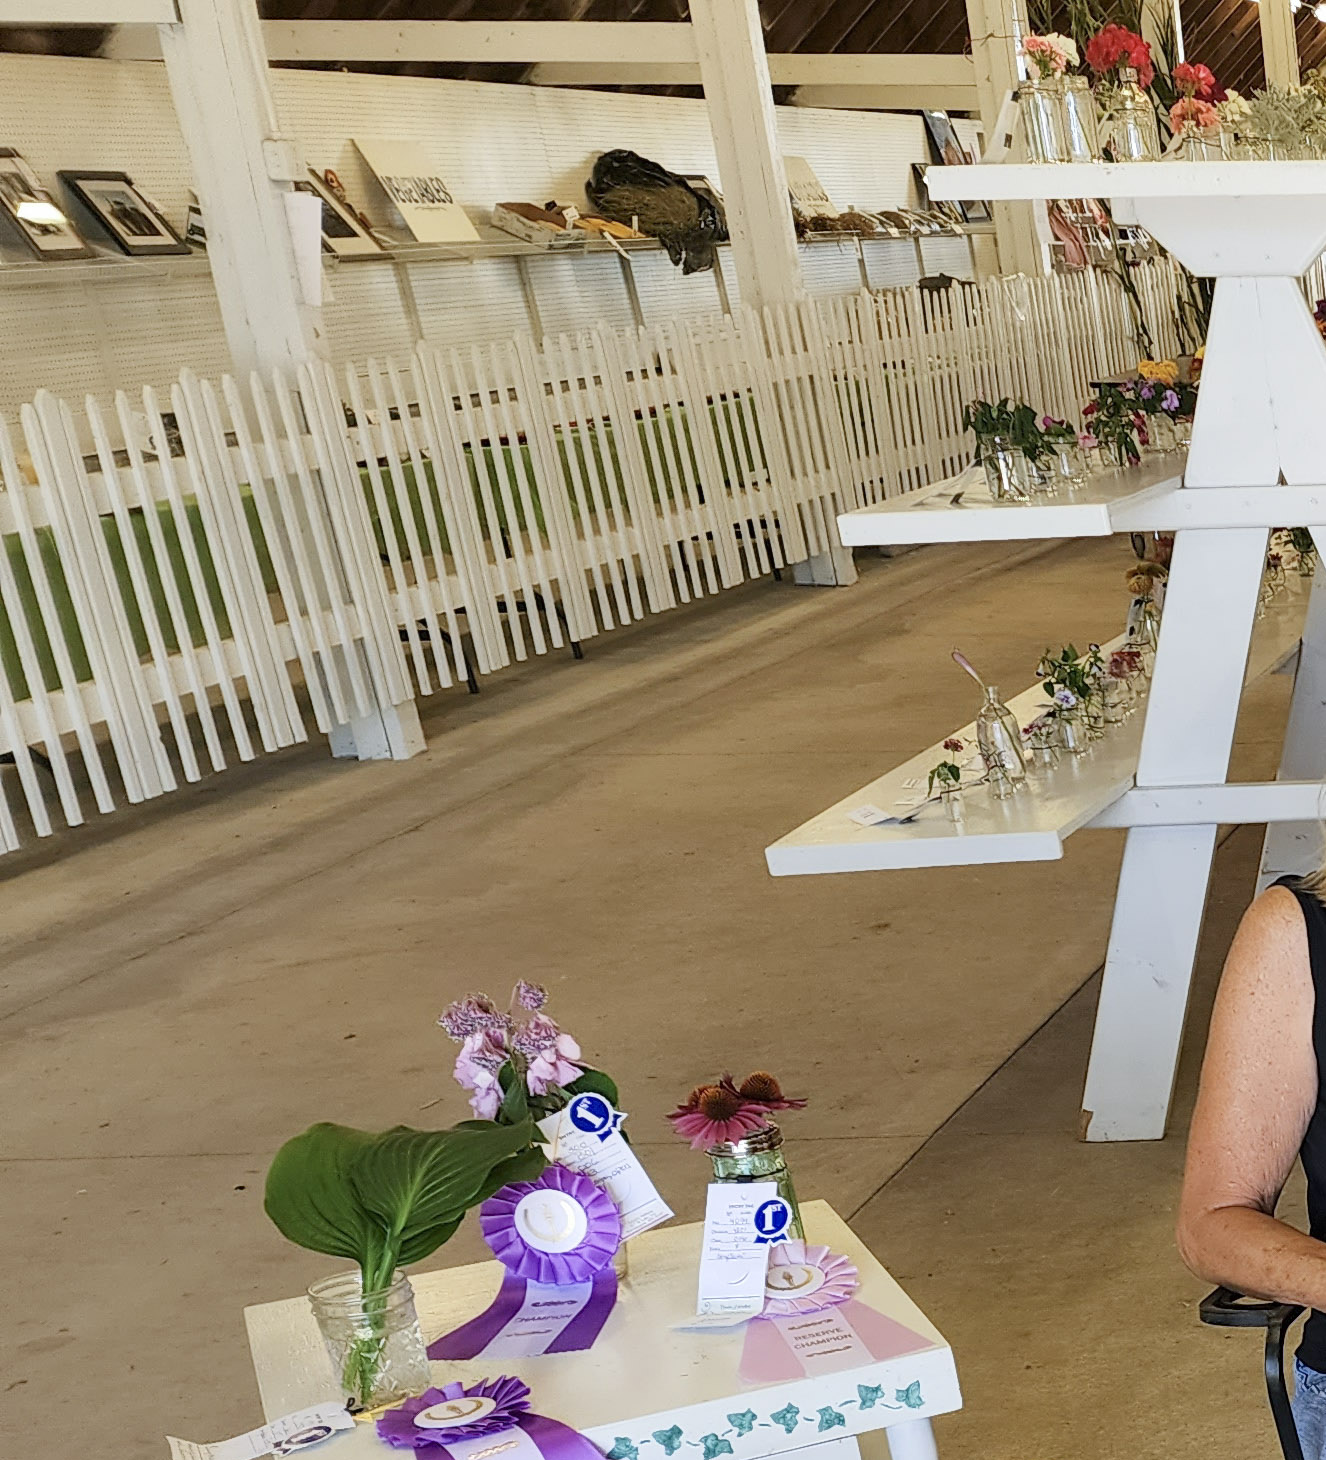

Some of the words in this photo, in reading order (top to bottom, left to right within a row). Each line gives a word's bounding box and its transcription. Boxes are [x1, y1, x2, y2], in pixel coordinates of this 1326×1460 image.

[380, 176, 453, 204] VEGETABLES
[762, 1204, 783, 1232] 1ST
[794, 1327, 843, 1341] RESERVE
[794, 1333, 853, 1350] CHAMPION
